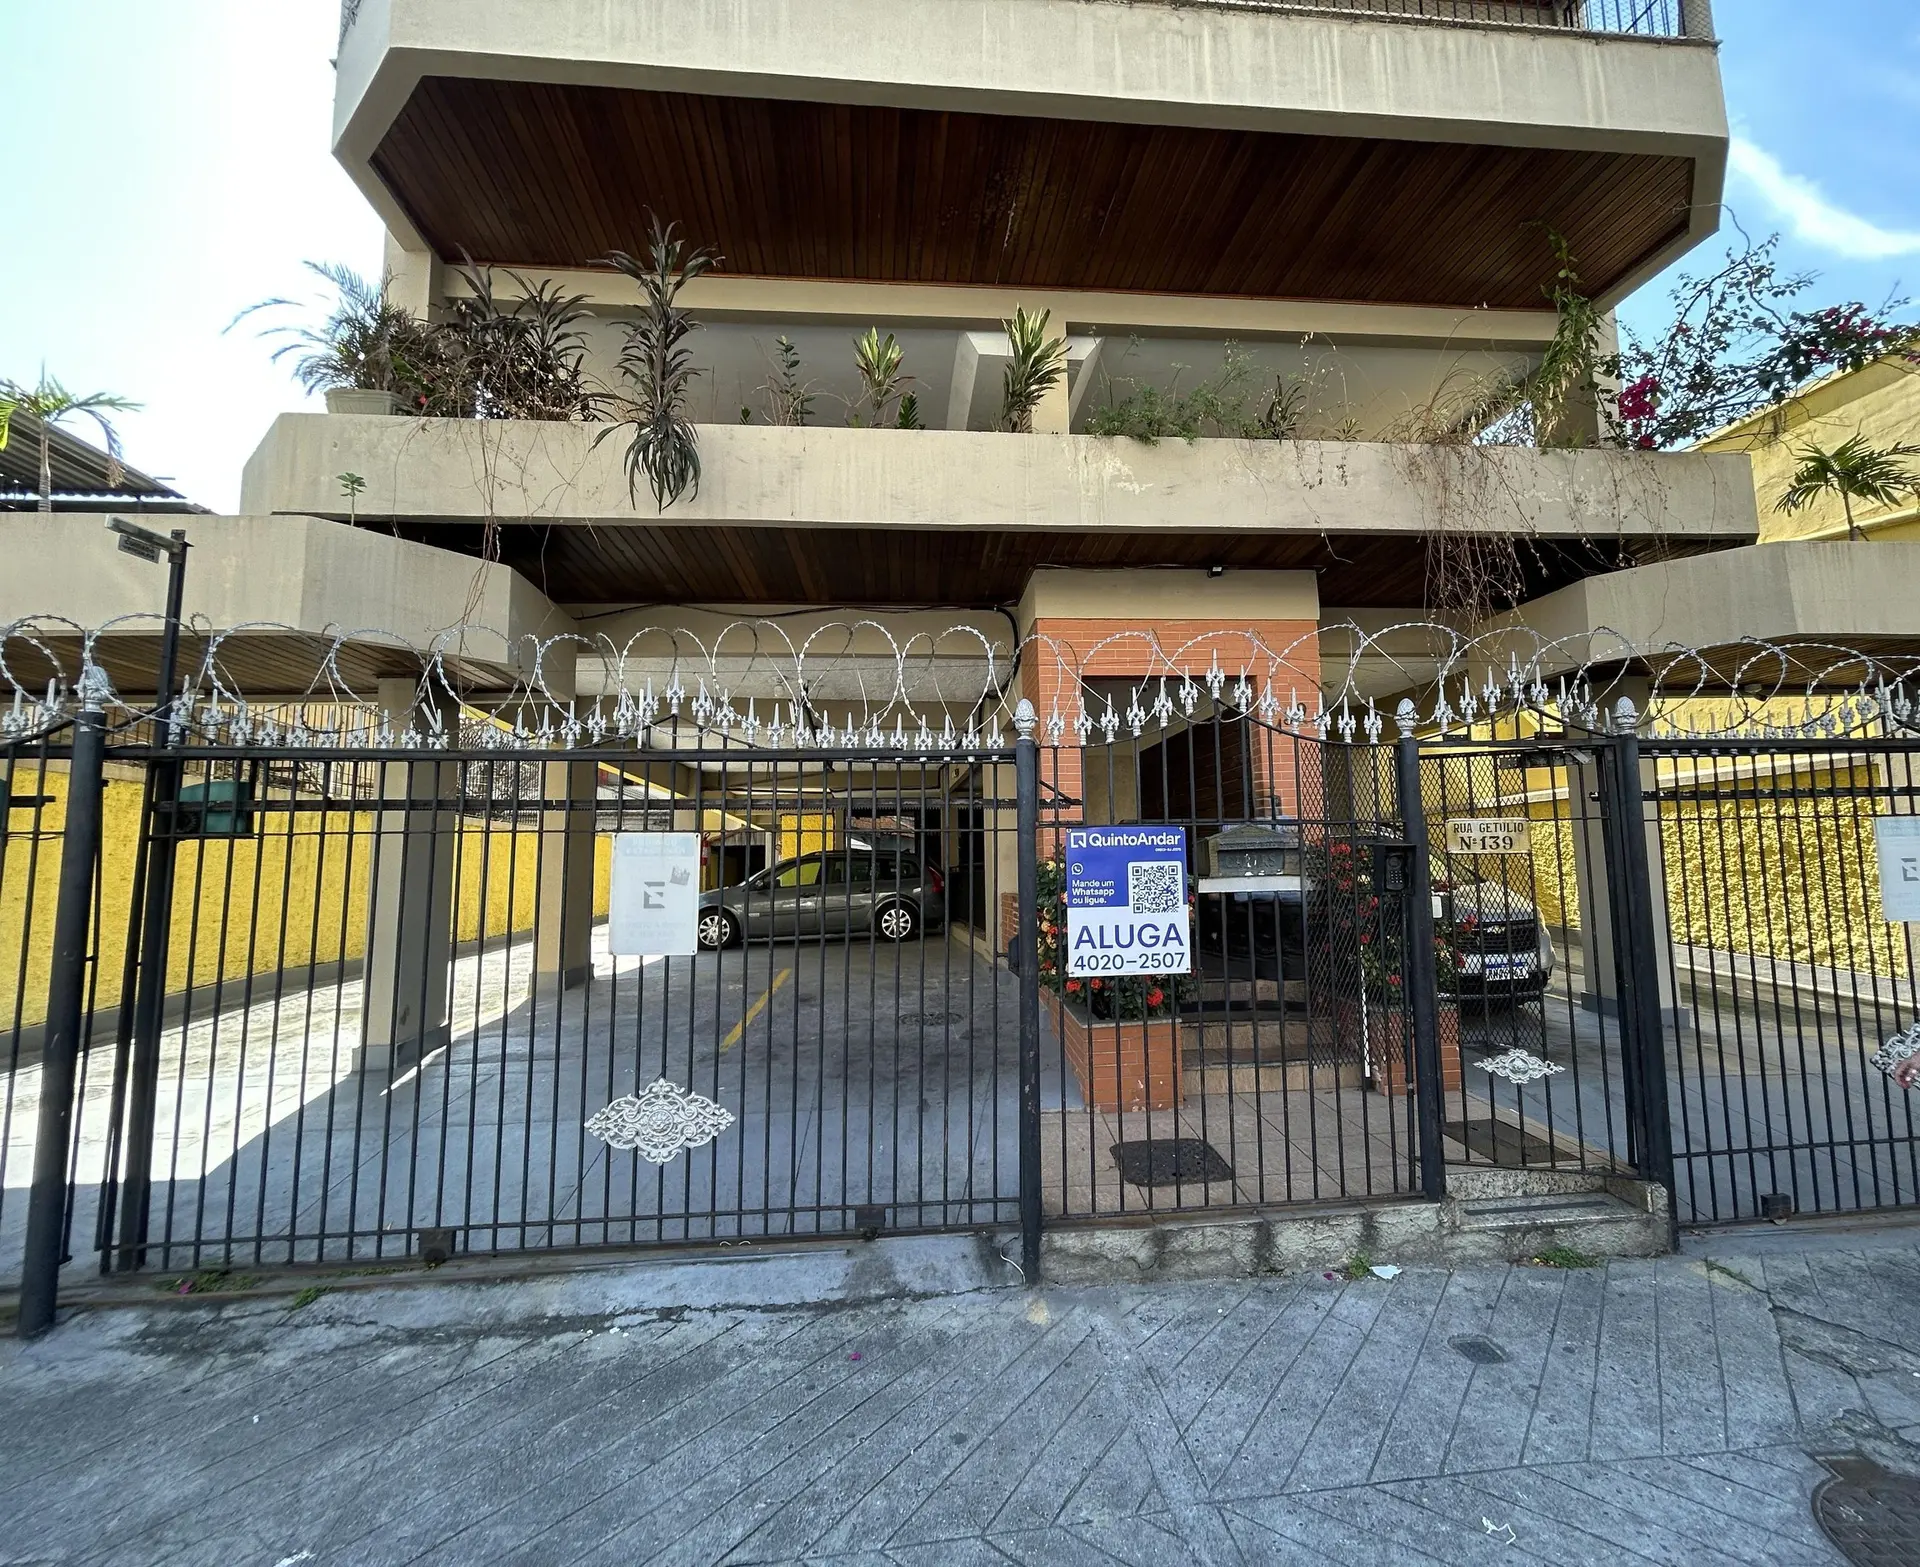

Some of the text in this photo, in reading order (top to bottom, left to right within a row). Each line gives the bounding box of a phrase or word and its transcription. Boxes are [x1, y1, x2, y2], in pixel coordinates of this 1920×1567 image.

[1453, 822, 1524, 834] RUA GETULIO
[1088, 832, 1181, 848] QuintoAndar
[1072, 879, 1100, 888] Mande
[1072, 887, 1115, 897] Whatsapp
[1084, 896, 1107, 905] ligue.
[1074, 923, 1184, 950] ALUGA
[1073, 952, 1185, 971] 4020-2507
